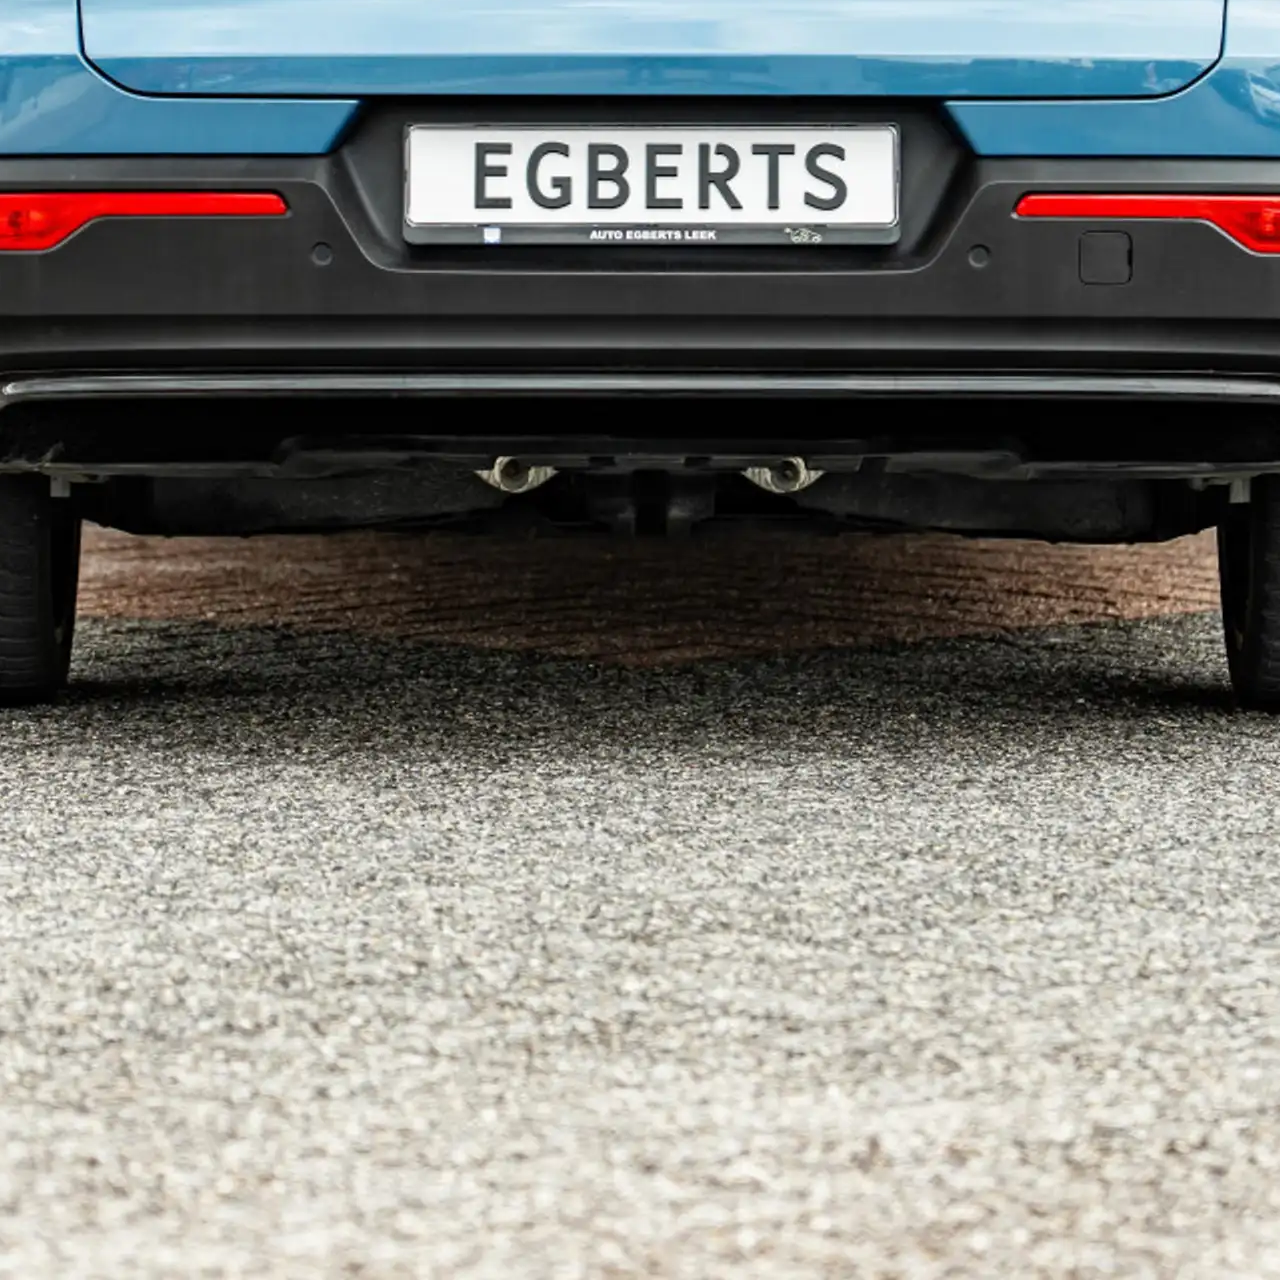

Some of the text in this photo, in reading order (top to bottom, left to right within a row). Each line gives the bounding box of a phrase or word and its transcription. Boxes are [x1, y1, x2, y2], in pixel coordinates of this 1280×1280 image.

[474, 142, 848, 211] EGBERTS
[589, 229, 717, 240] AUTO EGBERTS LEEK
